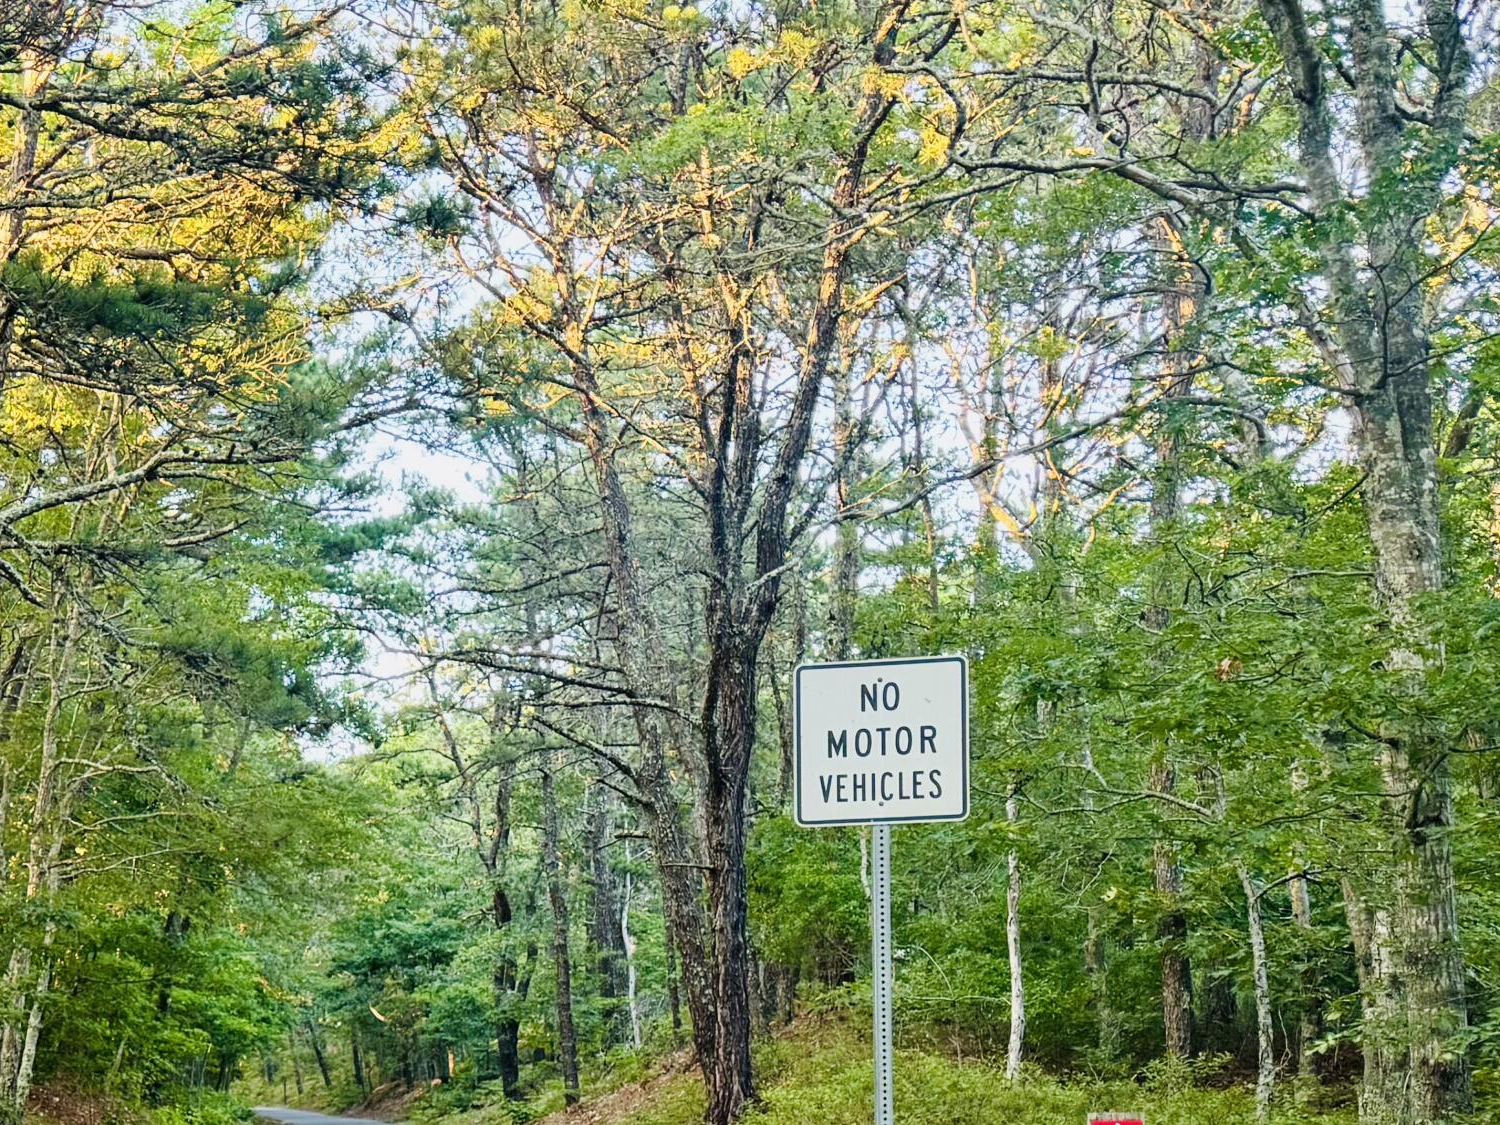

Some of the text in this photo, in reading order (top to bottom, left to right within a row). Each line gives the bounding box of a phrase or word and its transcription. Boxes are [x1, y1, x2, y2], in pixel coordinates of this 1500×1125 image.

[860, 681, 900, 712] NO
[827, 725, 937, 758] MOTOR
[819, 769, 942, 803] VEHICLES
